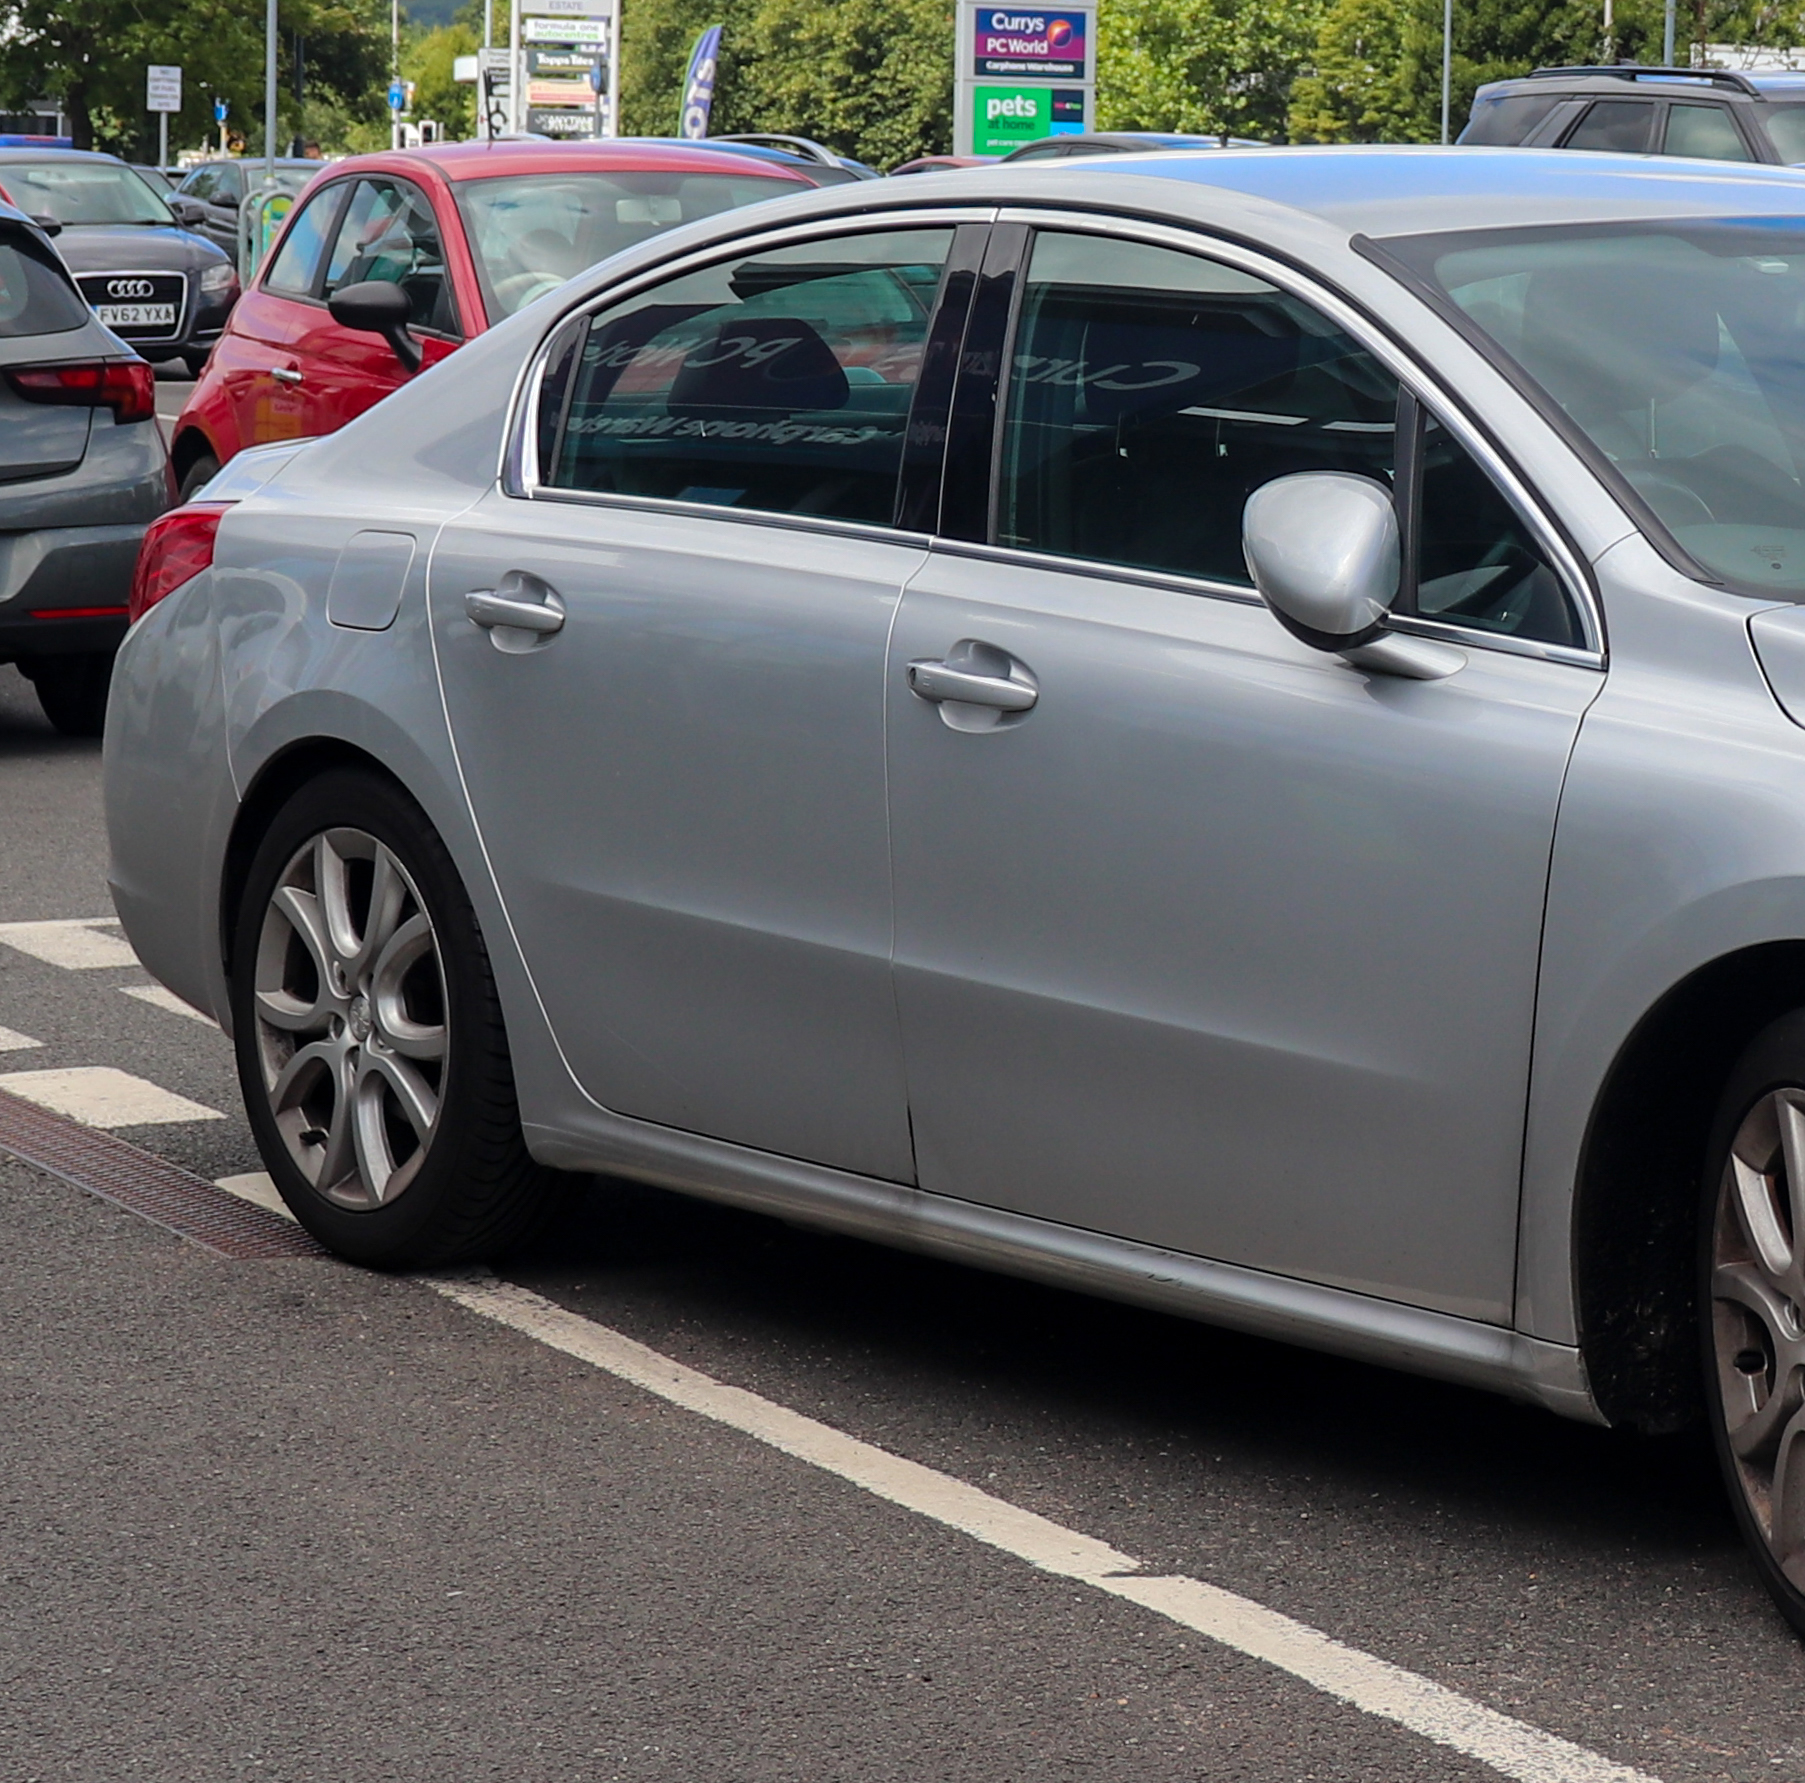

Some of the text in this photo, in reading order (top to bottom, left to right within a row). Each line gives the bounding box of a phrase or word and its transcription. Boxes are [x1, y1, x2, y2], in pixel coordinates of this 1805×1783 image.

[548, 1, 584, 10] ESTATE
[534, 22, 576, 31] formula
[991, 12, 1045, 34] Currys
[534, 30, 599, 39] autocentres
[986, 38, 1048, 54] PC World
[987, 95, 1037, 119] pets
[988, 117, 1035, 130] at home
[100, 307, 172, 322] FV62 YXA
